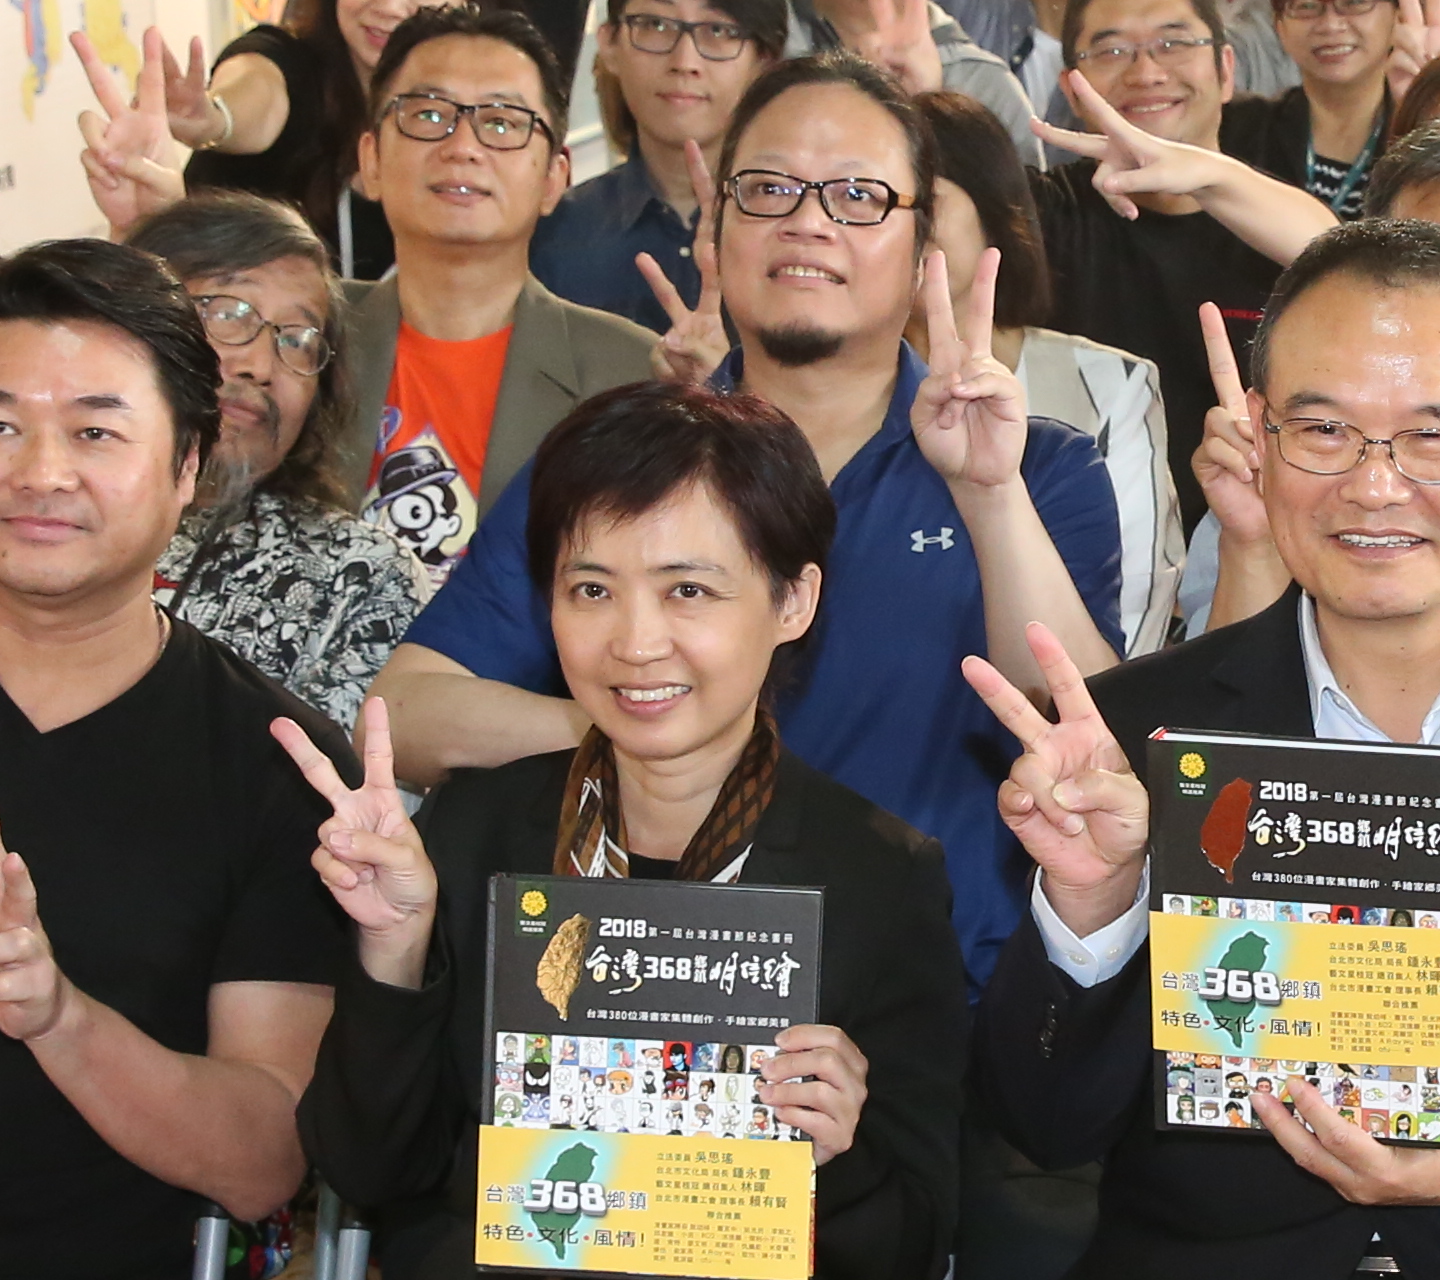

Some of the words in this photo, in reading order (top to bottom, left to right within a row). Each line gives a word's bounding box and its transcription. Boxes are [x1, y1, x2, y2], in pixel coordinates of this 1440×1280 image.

[1160, 966, 1324, 1005] 台灣368鄉鎮
[485, 1178, 648, 1217] 台灣368鄉鎮
